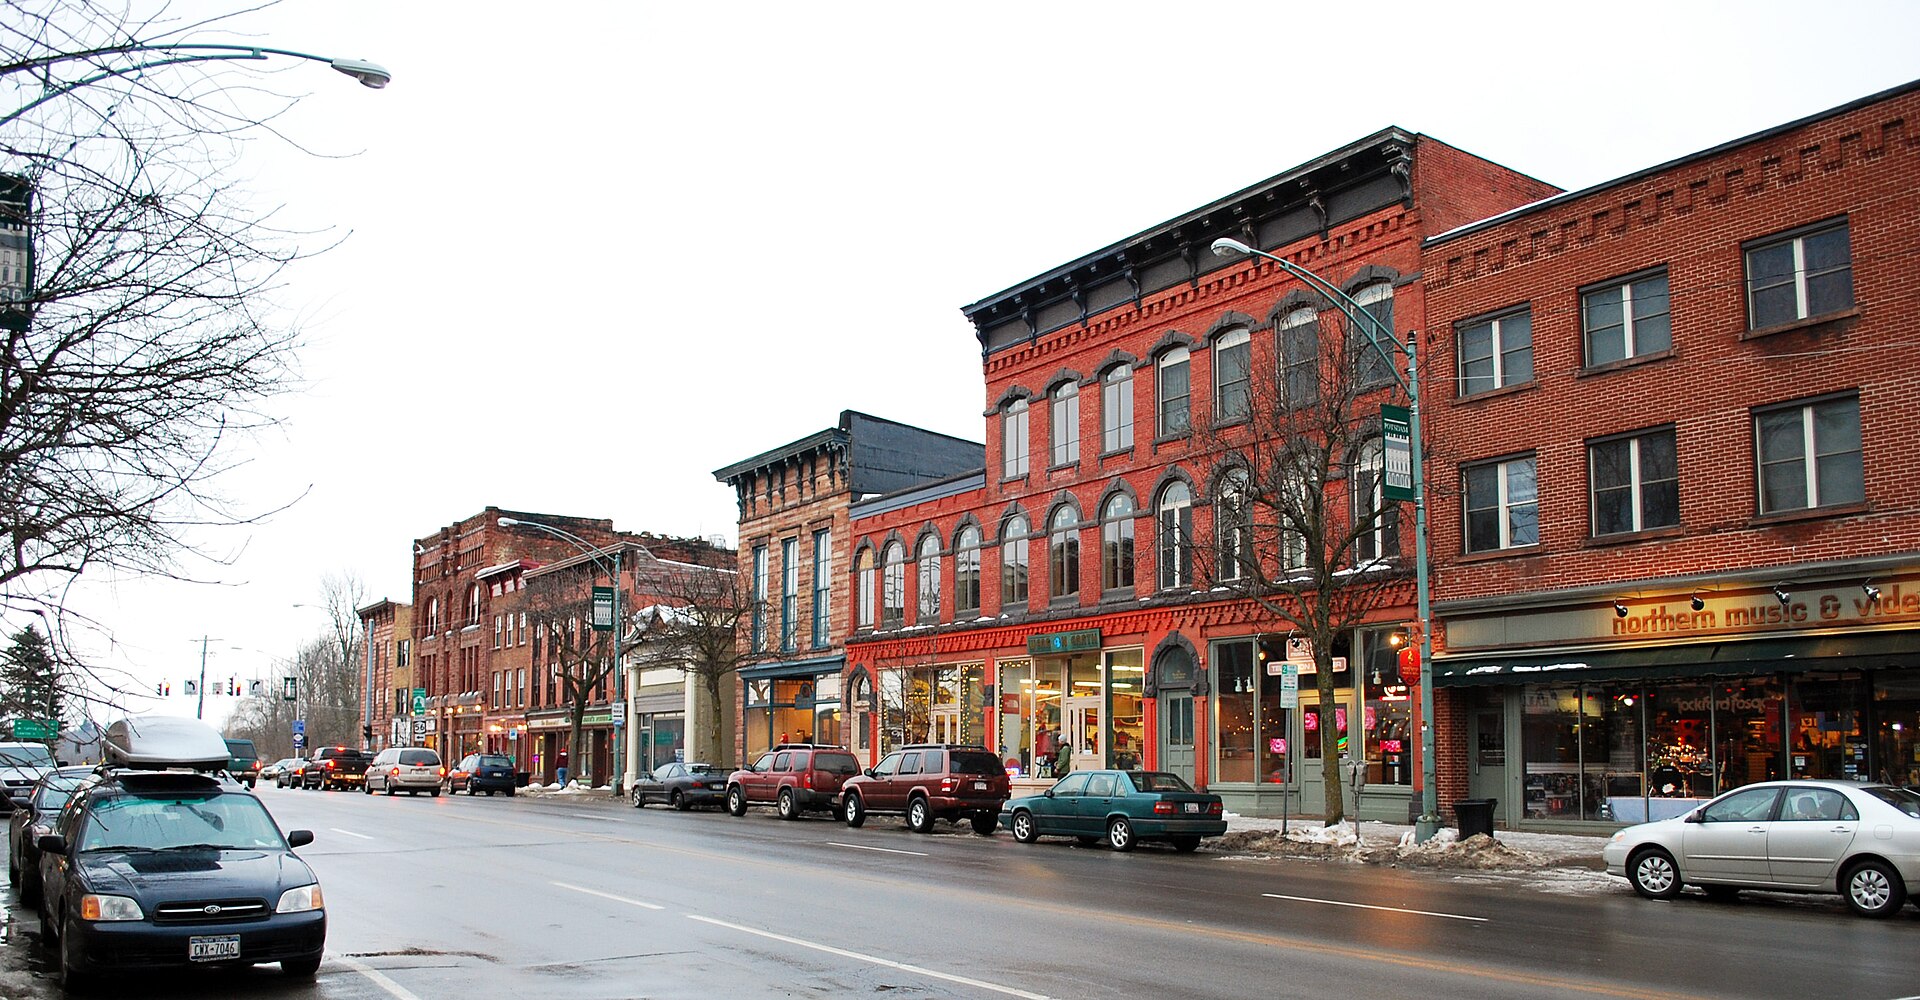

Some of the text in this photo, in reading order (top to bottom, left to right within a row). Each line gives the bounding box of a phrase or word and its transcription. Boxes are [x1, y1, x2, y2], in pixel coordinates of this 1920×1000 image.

[1612, 605, 1716, 635] northern
[1725, 603, 1808, 626] music
[1819, 595, 1841, 619] &
[1282, 665, 1287, 674] 2
[414, 723, 425, 731] 56
